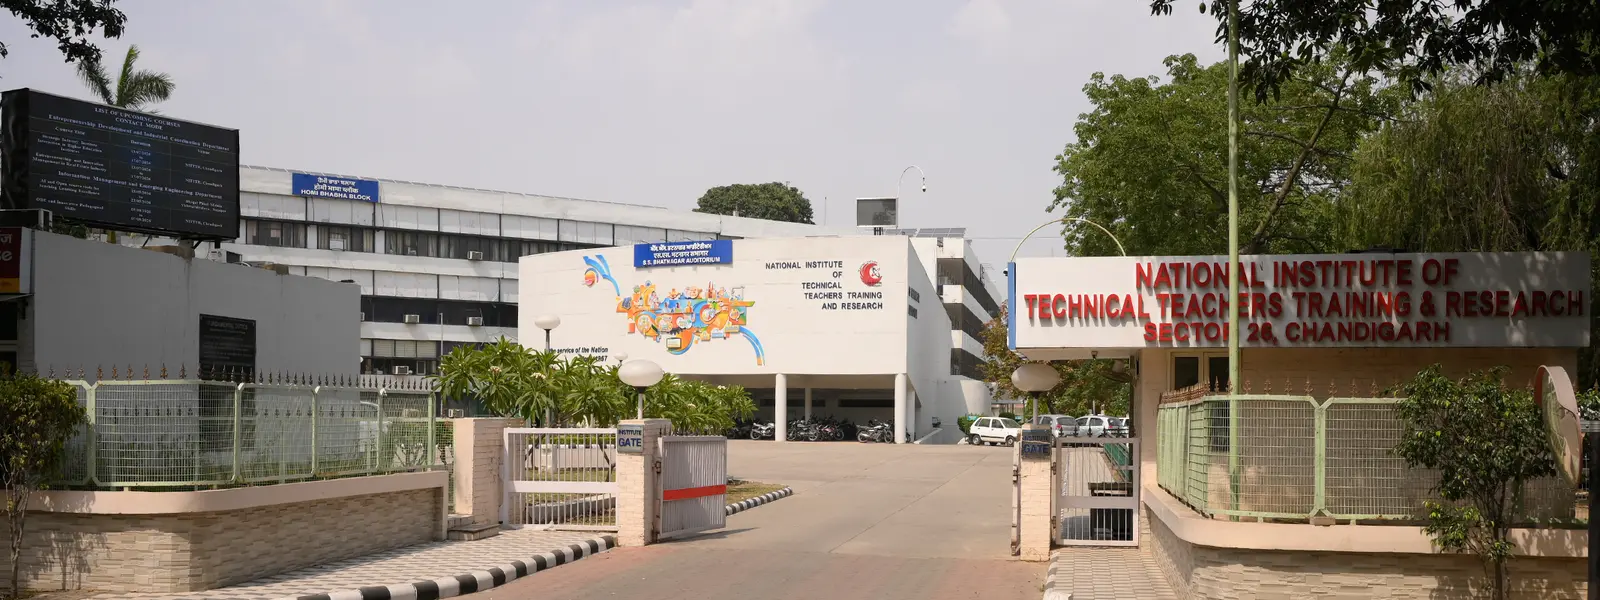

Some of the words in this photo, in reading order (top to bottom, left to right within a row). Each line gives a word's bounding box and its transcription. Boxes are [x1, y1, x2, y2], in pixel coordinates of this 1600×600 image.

[115, 117, 142, 126] CONTACT
[145, 122, 162, 130] MODE
[119, 112, 151, 122] UPCOMING
[153, 118, 180, 127] COURSES
[98, 123, 131, 133] Development
[143, 131, 167, 140] Industrial
[202, 142, 229, 151] Department
[92, 175, 126, 185] Management
[320, 191, 348, 199] BHABHA
[765, 262, 802, 270] NATIONAL
[805, 260, 843, 268] INSTITUTE
[832, 271, 843, 279] OF
[1136, 262, 1265, 288] NATIONAL
[1274, 259, 1413, 287] INSTITUTE
[1421, 258, 1460, 286] OF
[802, 282, 843, 290] TECHNICAL
[804, 292, 843, 300] TEACHERS
[847, 291, 883, 299] TRAINING
[841, 302, 884, 310] RESEARCH
[1024, 293, 1150, 319] TECHNICAL
[1156, 292, 1283, 318] TEACHERS
[1291, 291, 1412, 318] TRAINING
[1419, 290, 1436, 317] &
[1445, 290, 1584, 317] RESEARCH
[1285, 321, 1450, 342] CHANDIGARH
[619, 438, 642, 447] GATE
[1024, 444, 1049, 453] GATE
